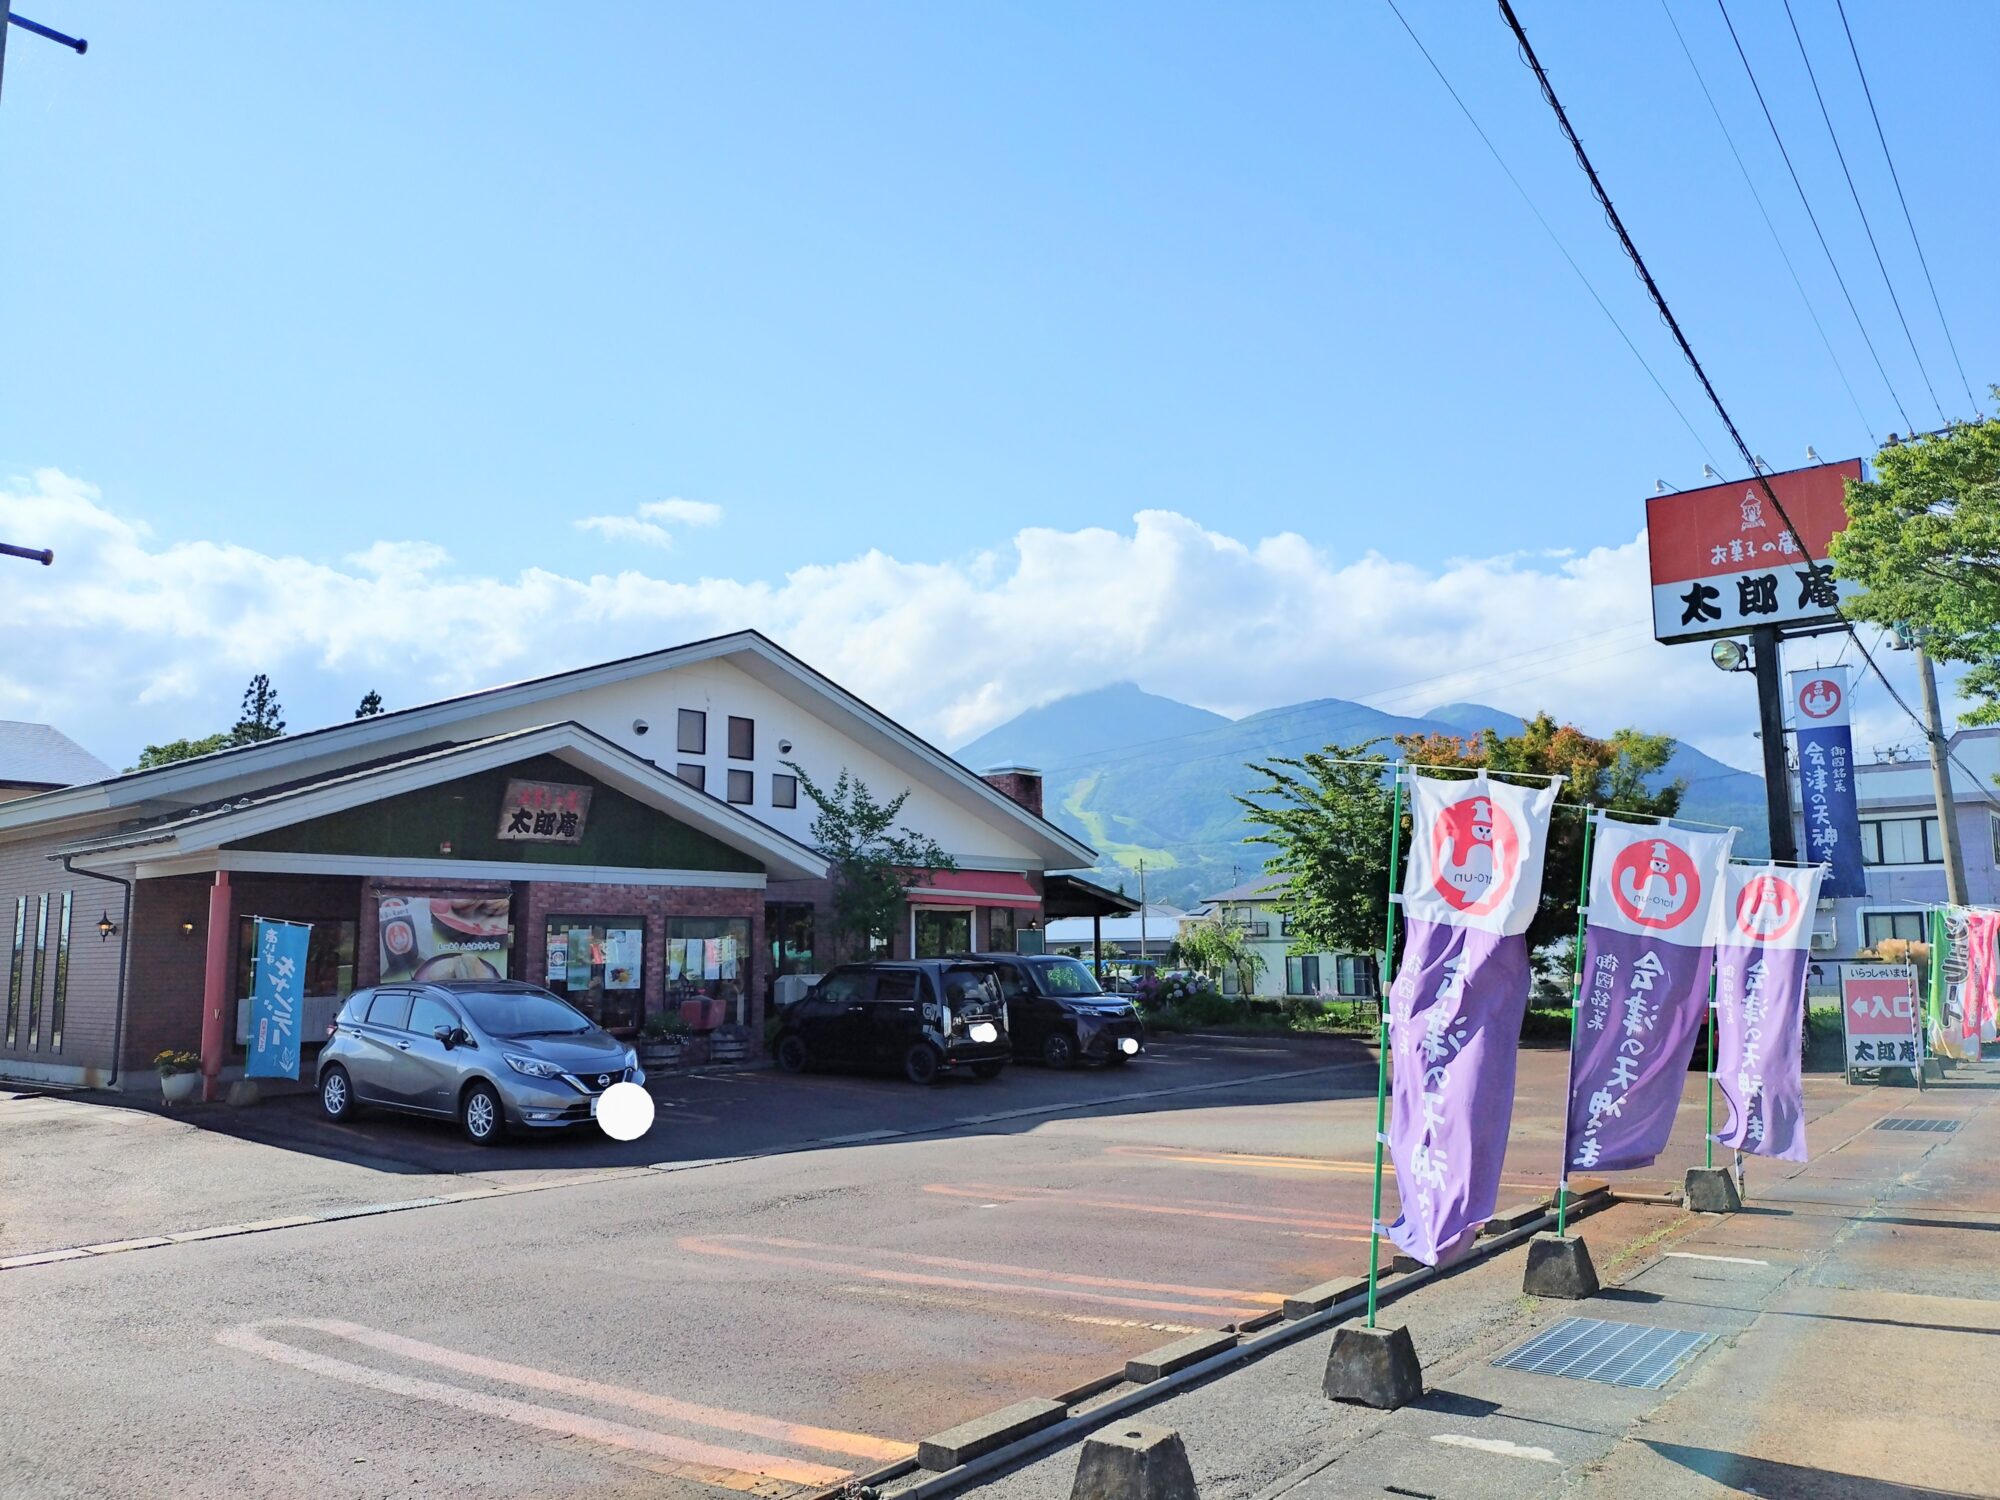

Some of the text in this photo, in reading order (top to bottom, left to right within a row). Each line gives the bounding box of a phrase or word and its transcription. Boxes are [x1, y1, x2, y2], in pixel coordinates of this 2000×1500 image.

[1711, 530, 1800, 565] お菓子の蔵
[1681, 565, 1840, 625] 太郎庵
[508, 807, 579, 837] 太郎庵
[1850, 968, 1909, 978] いらっしゃいませ
[1870, 996, 1911, 1018] 入口
[1855, 1040, 1916, 1062] 太郎庵
